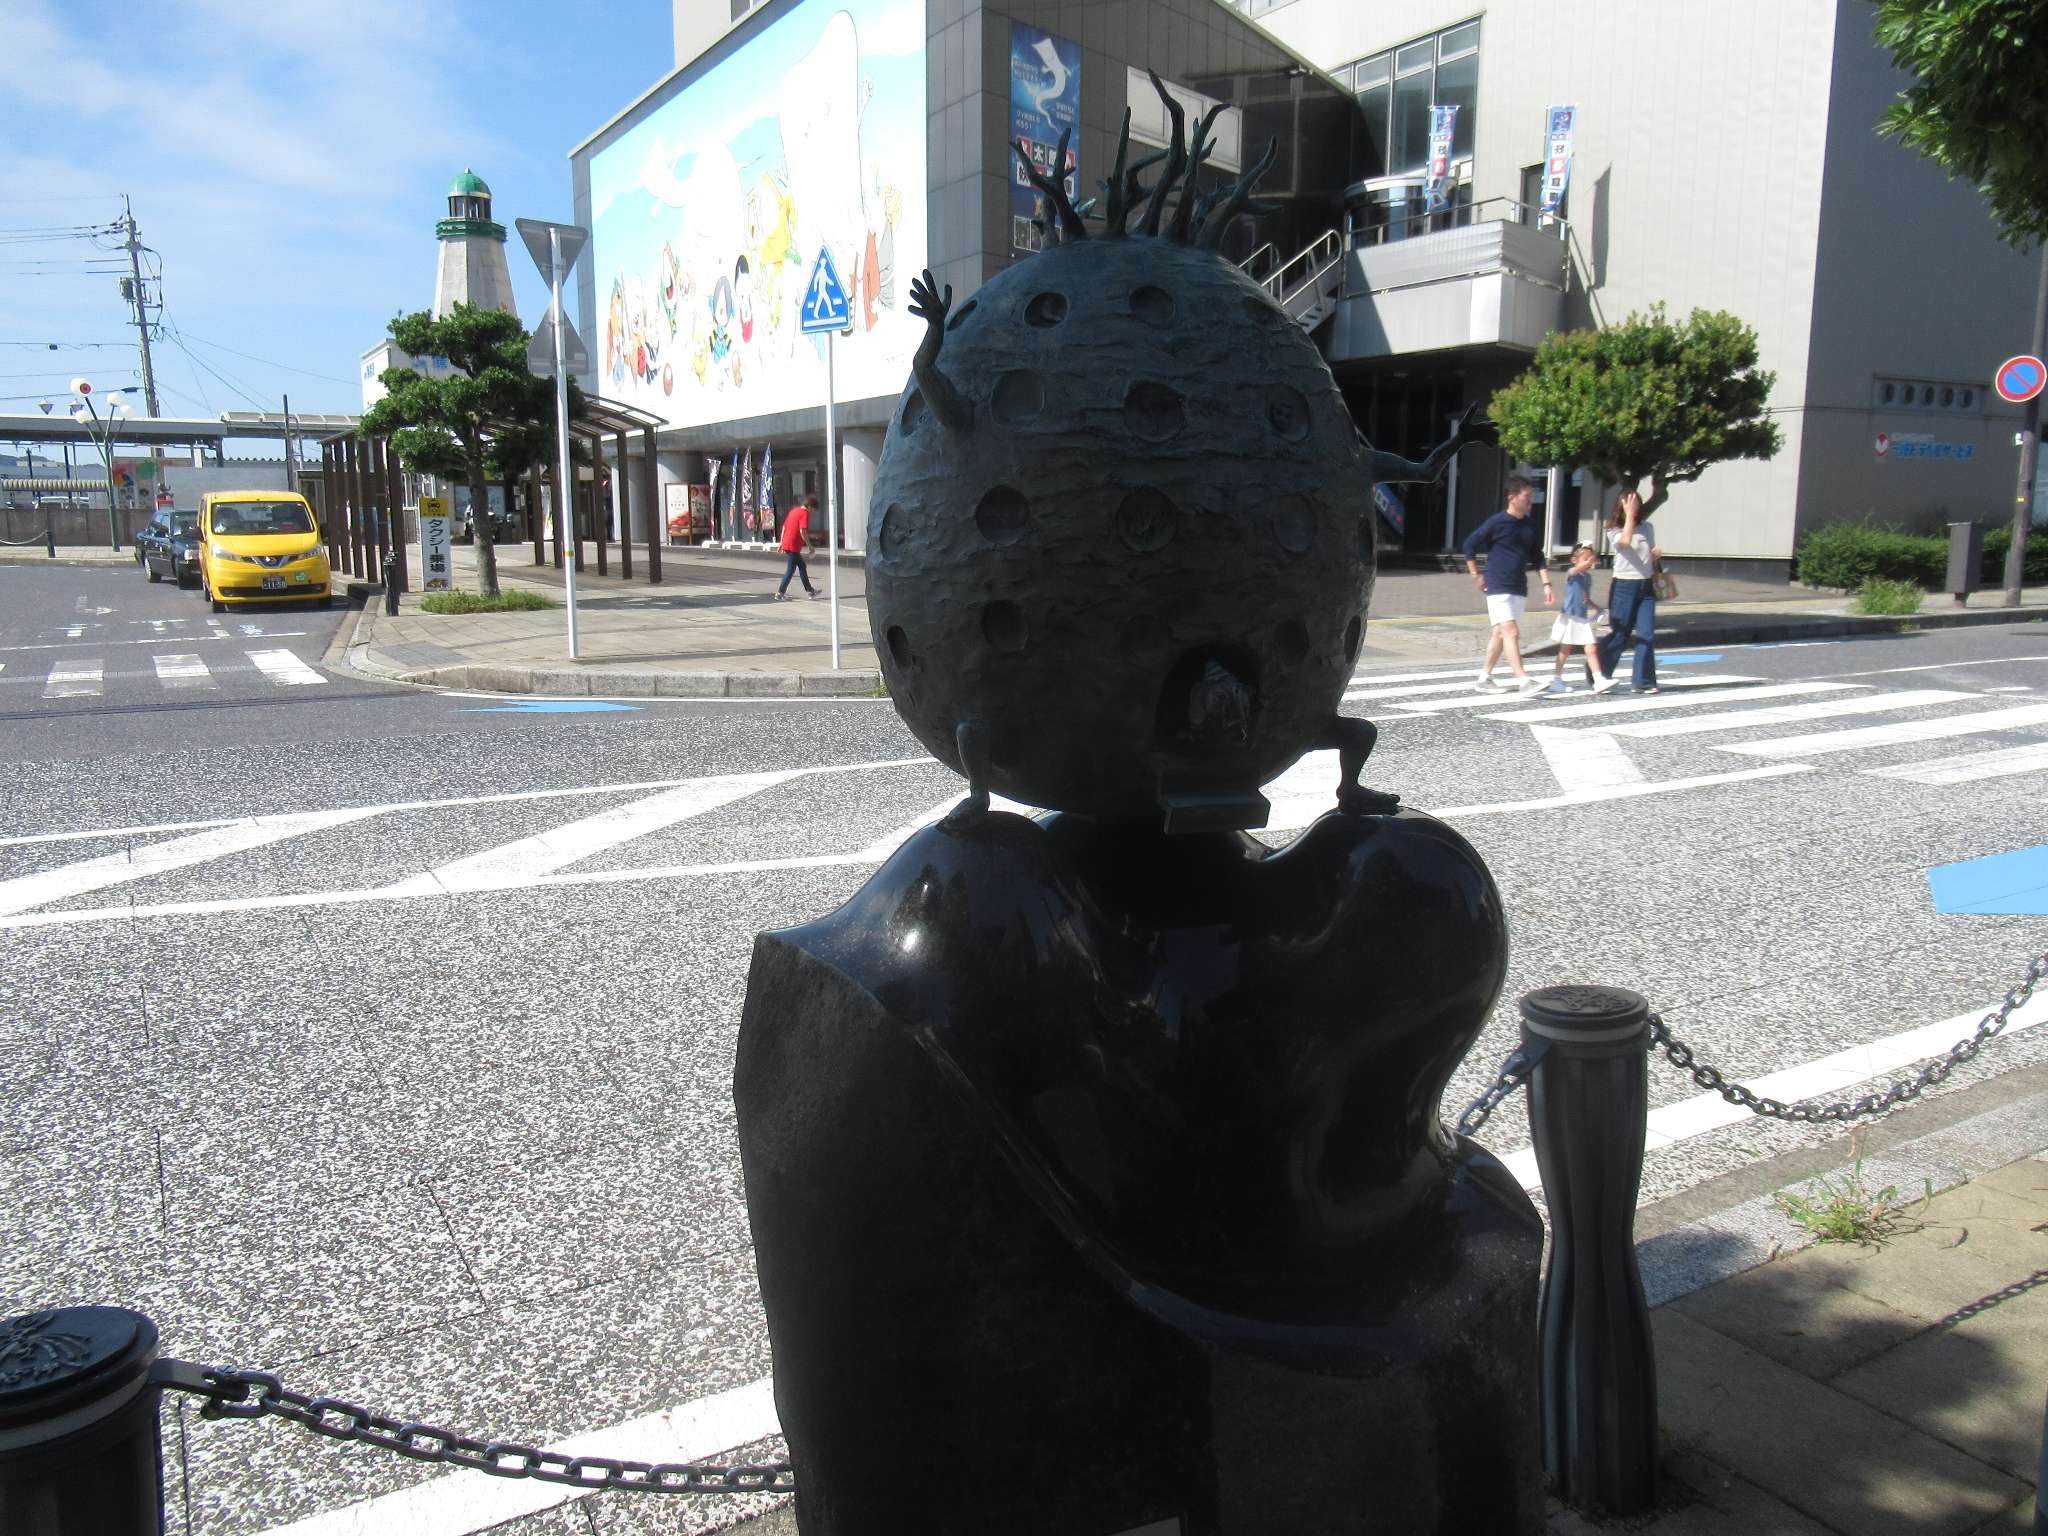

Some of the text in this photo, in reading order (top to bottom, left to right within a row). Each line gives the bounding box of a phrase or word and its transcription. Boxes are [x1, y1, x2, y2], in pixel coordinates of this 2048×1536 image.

[428, 518, 446, 573] タクシー乗場
